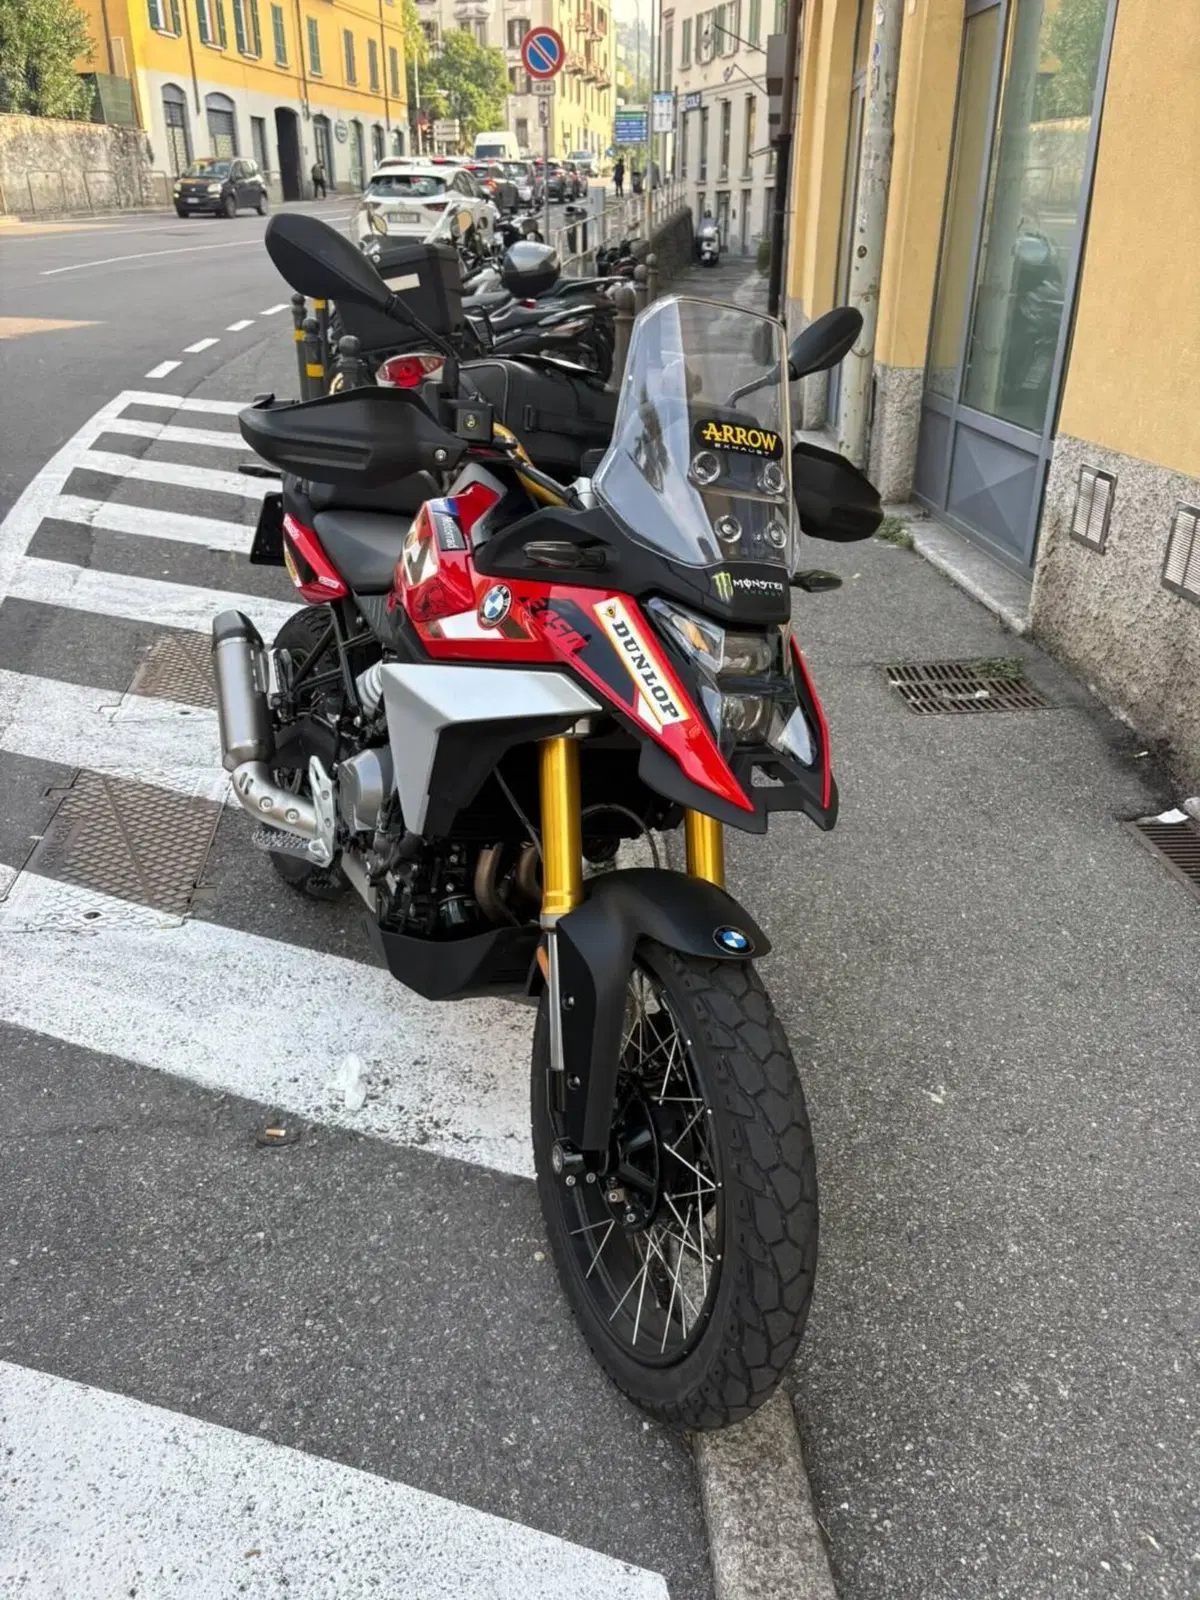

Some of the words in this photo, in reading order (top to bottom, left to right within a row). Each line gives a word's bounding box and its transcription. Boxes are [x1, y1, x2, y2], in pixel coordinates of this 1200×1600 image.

[702, 422, 777, 452] ARROW
[714, 442, 770, 457] EXHAUST
[612, 620, 680, 718] DUNLOP
